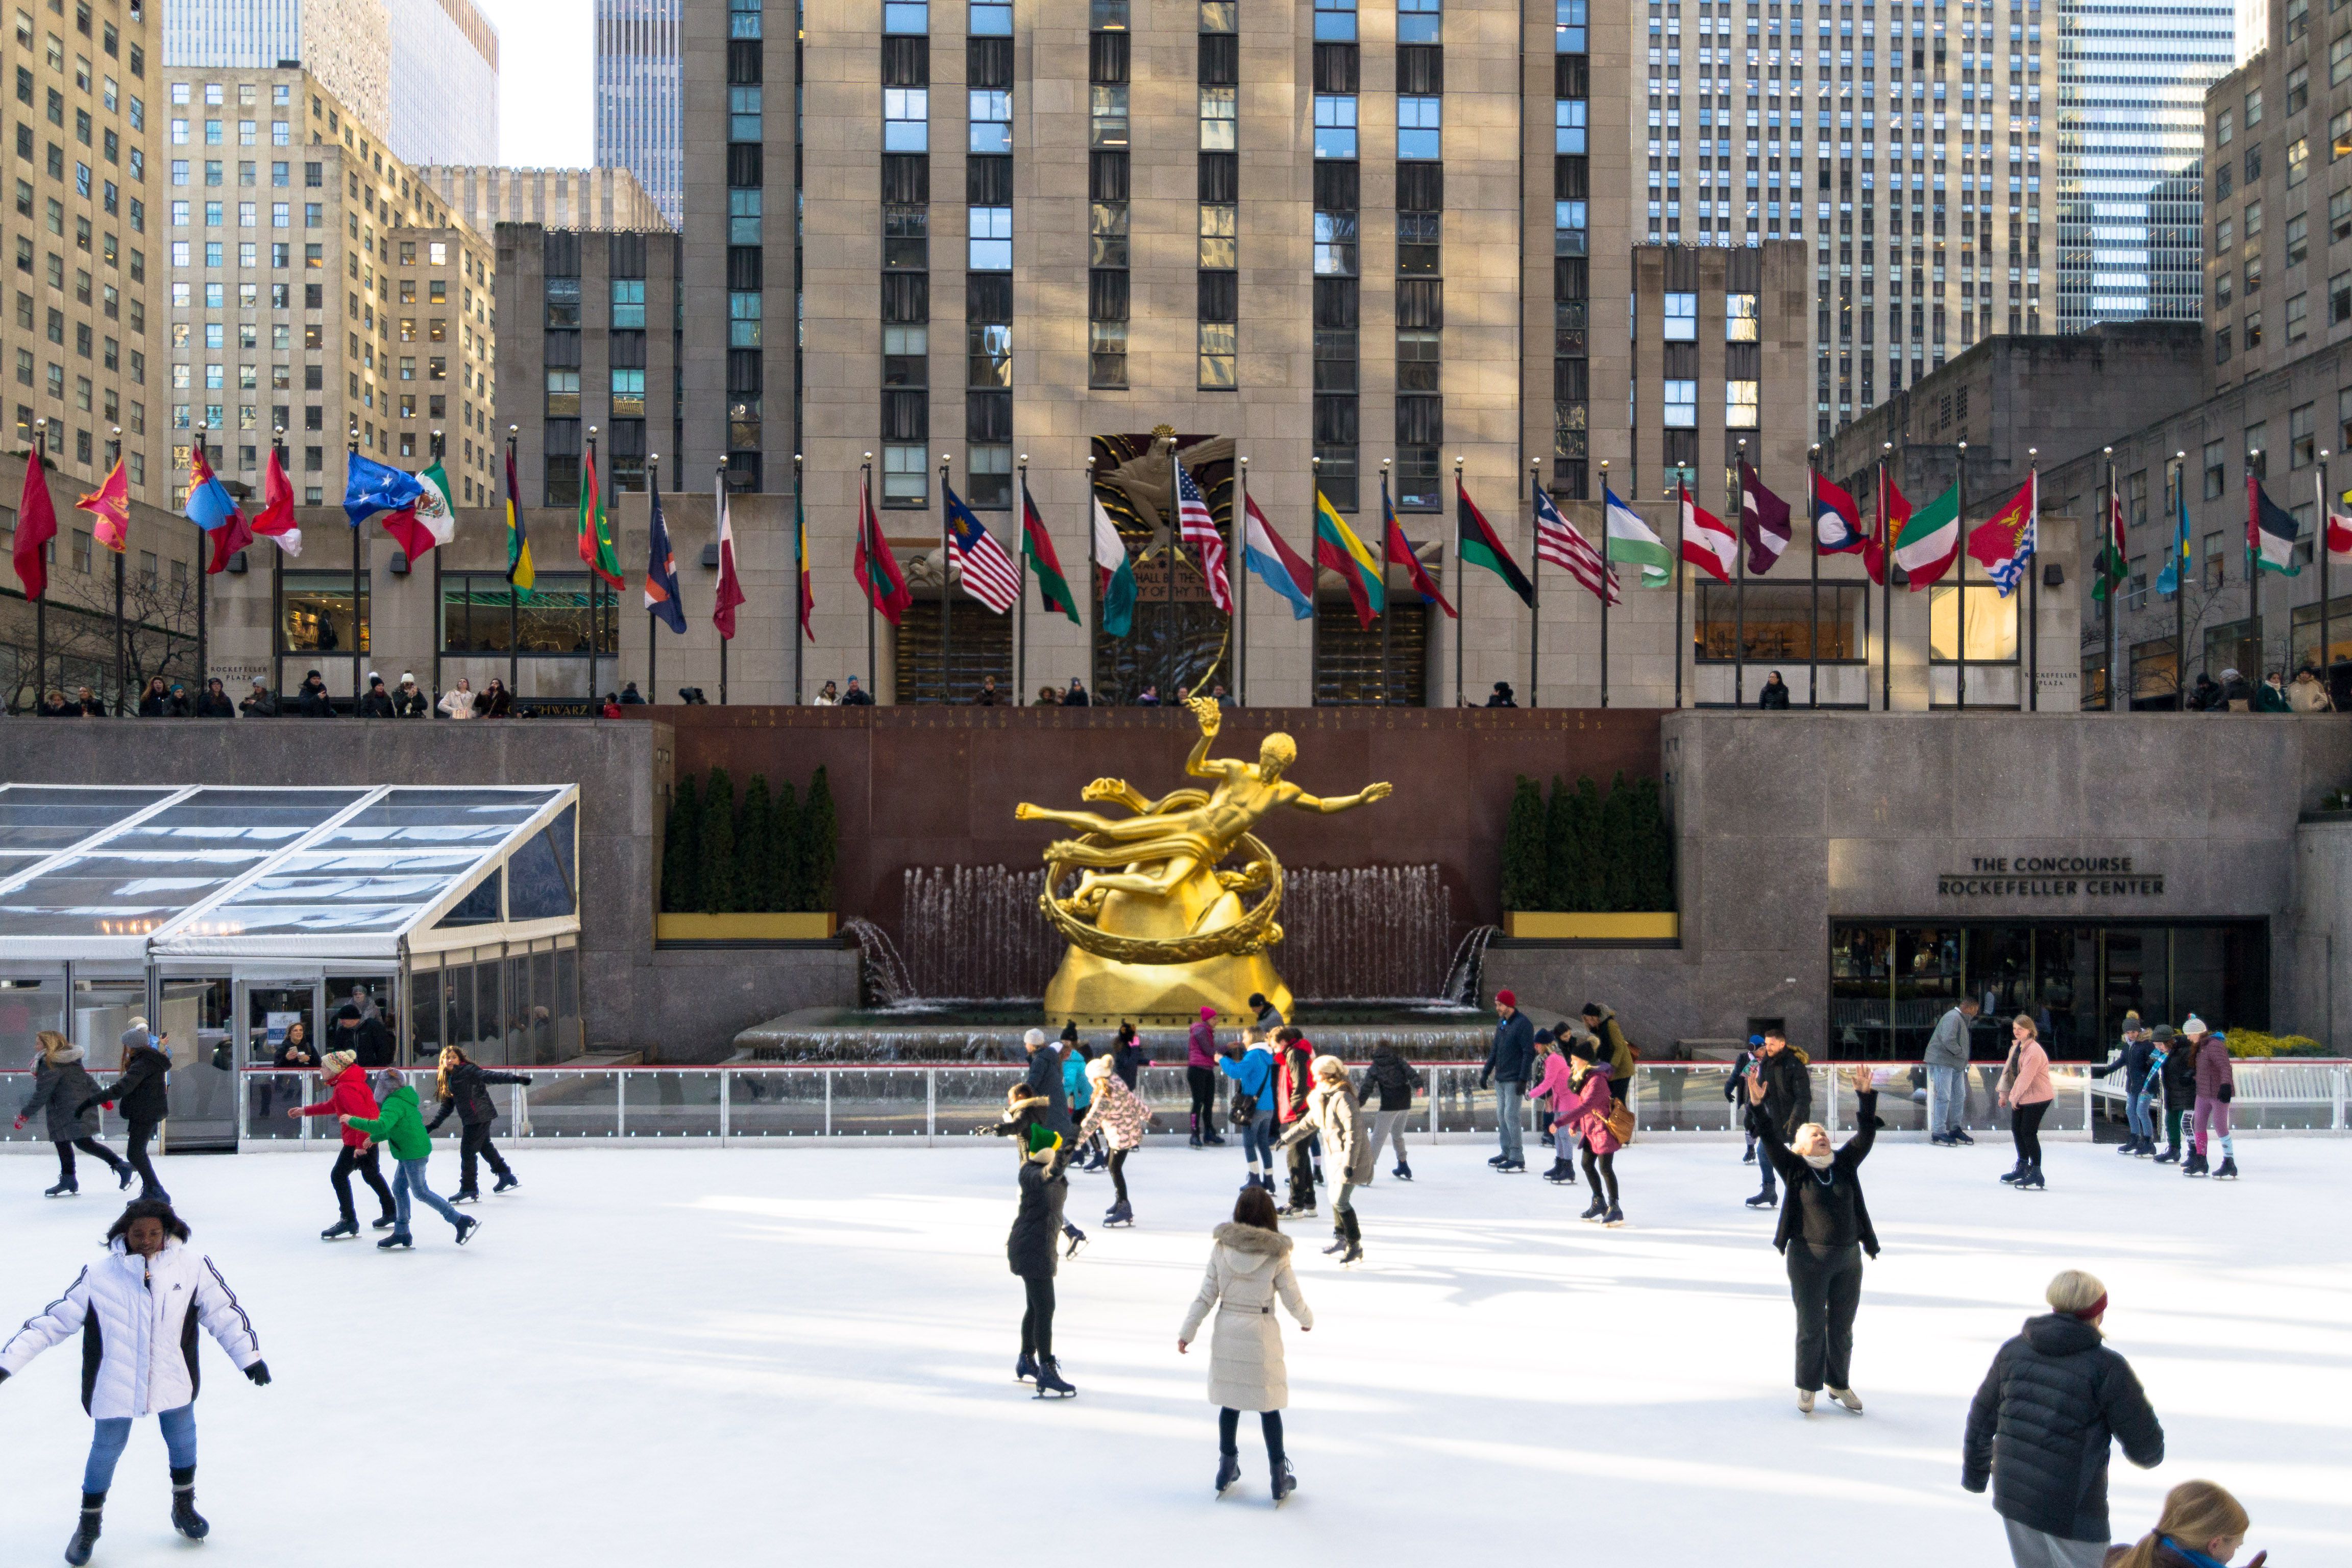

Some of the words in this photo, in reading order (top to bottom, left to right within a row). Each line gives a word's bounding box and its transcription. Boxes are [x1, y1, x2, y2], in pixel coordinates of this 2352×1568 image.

[1135, 573, 1160, 583] HALL
[1150, 586, 1166, 597] OF
[1089, 720, 1184, 728] MORTAL
[1972, 857, 2007, 872] THE
[2014, 857, 2133, 872] CONCOURSE
[1939, 880, 2077, 895] ROCKEFELLER
[2086, 880, 2164, 895] CENTER
[2182, 1113, 2193, 1136] SAVAGE
